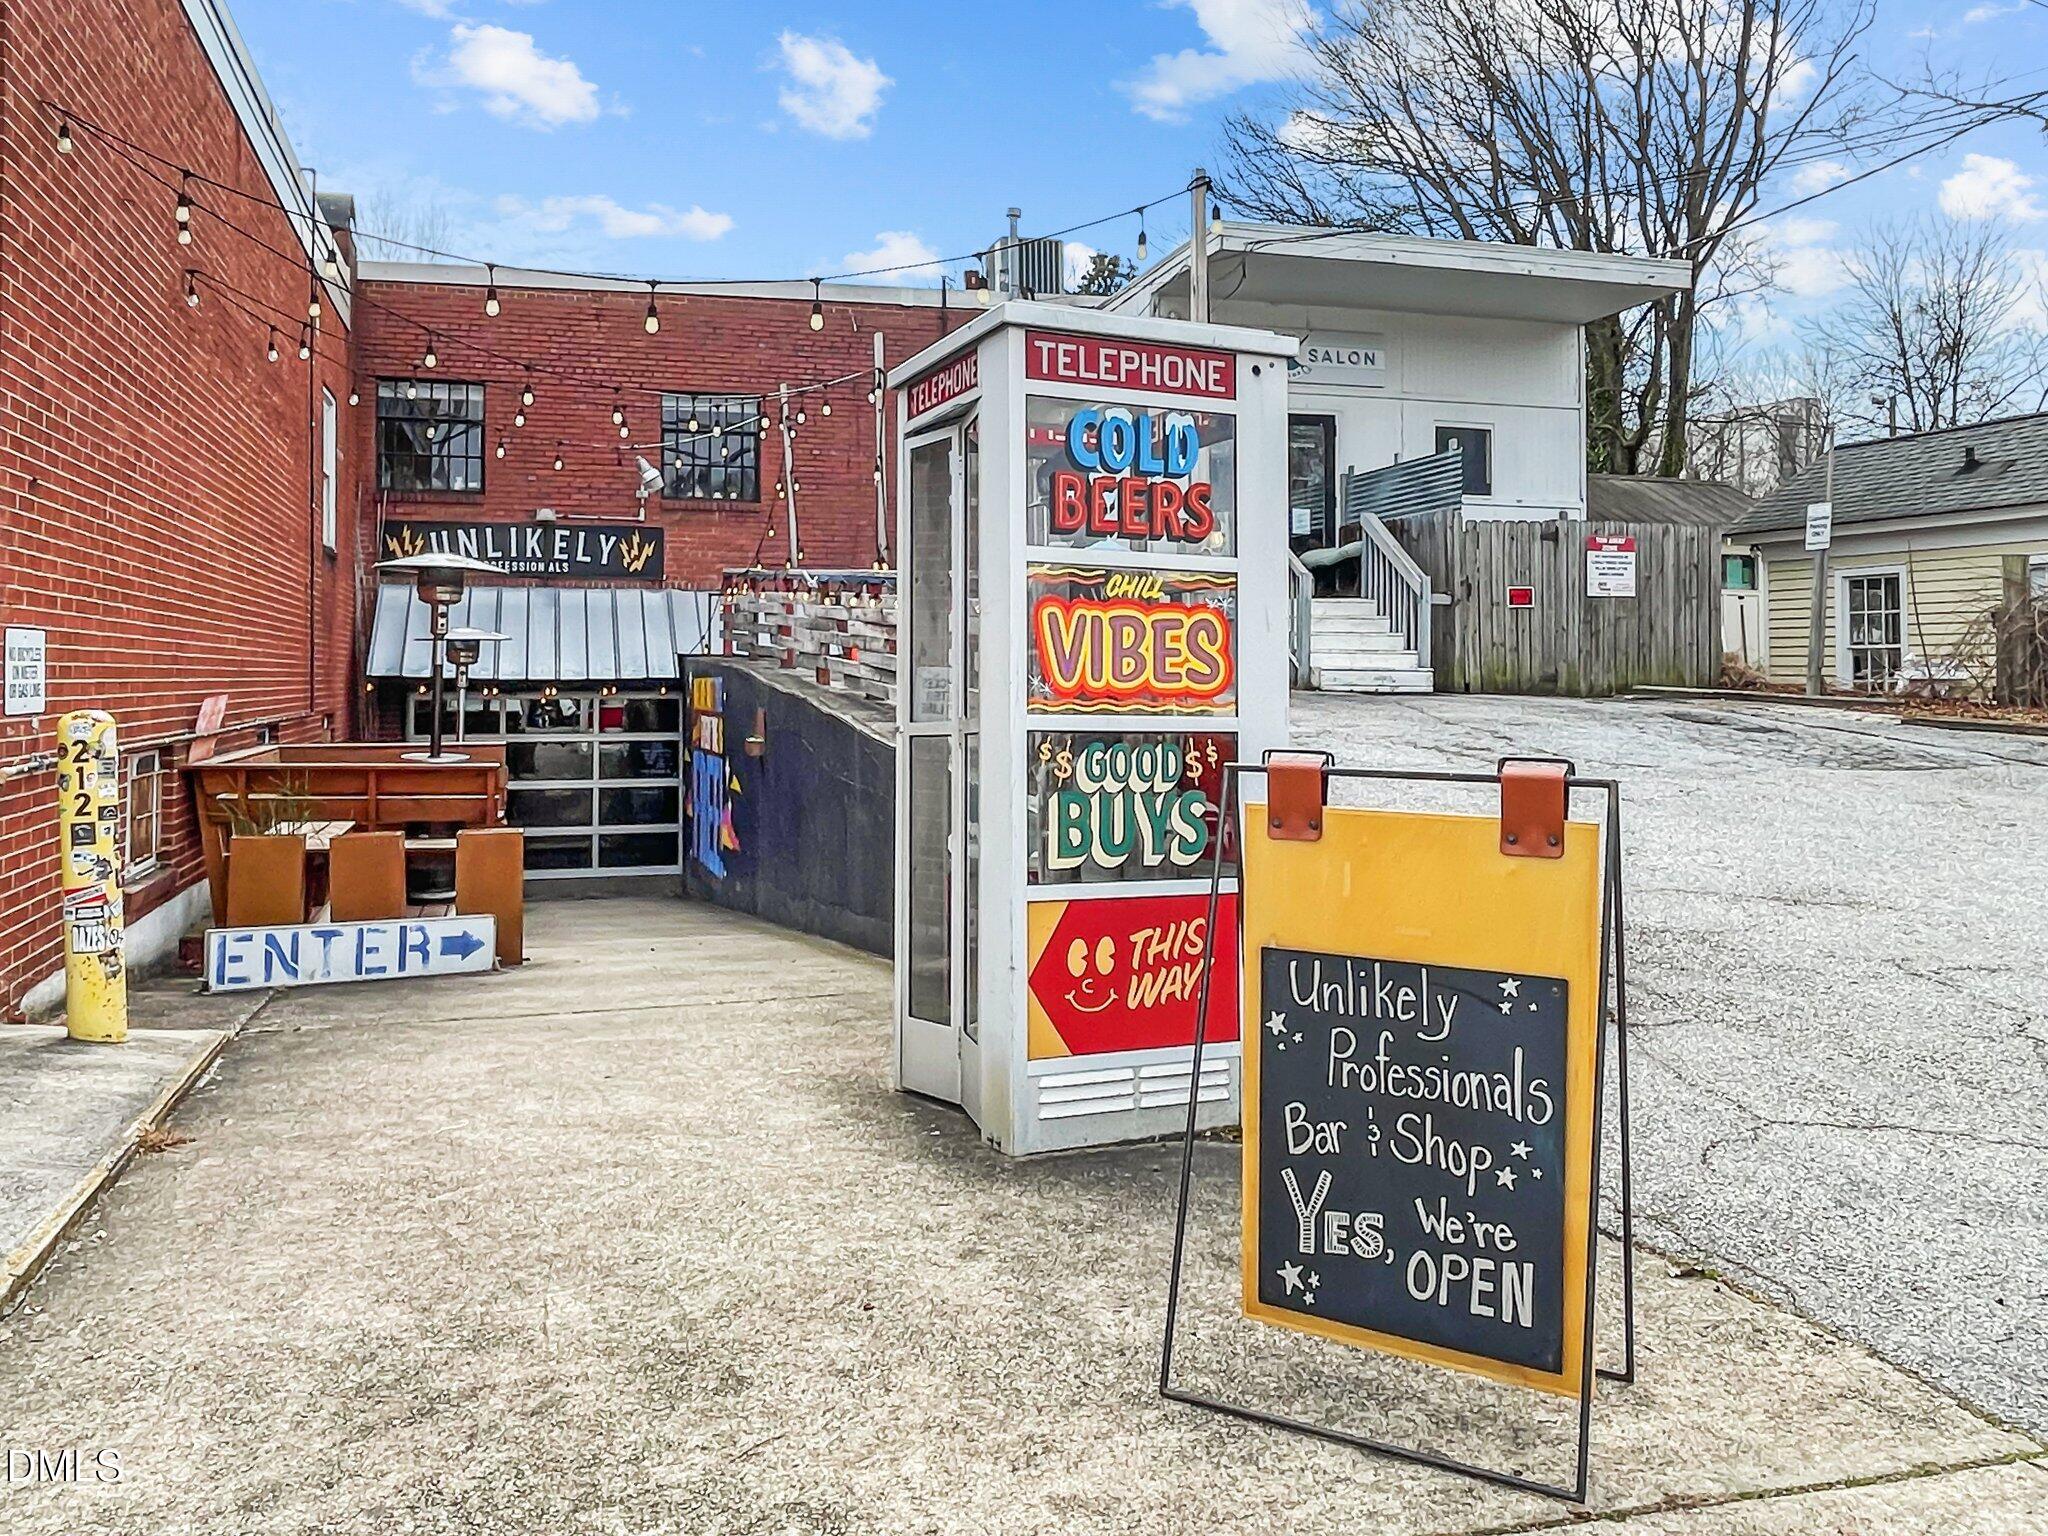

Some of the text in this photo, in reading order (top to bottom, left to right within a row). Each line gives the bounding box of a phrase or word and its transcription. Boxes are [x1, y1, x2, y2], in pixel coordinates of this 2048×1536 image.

[910, 354, 978, 416] TELEPHONE
[1033, 339, 1227, 393] TELEPHONE
[1307, 348, 1376, 366] SALON
[1065, 407, 1200, 475] COLD
[1050, 469, 1214, 542] BEERS
[429, 526, 618, 566] UNLIKELY
[1105, 573, 1165, 600] CHILL
[1040, 604, 1227, 693] VIBES
[1074, 741, 1183, 794] GOOD
[1047, 789, 1209, 870] BUYS
[215, 924, 432, 986] ENTER
[1129, 916, 1207, 970] THIS
[1288, 958, 1459, 1041] Unlikely
[1327, 1026, 1554, 1125] Professionals
[1283, 1101, 1348, 1156] Bar
[1389, 1112, 1493, 1197] Shop
[1413, 1196, 1518, 1252] We're
[1405, 1249, 1535, 1328] OPEN
